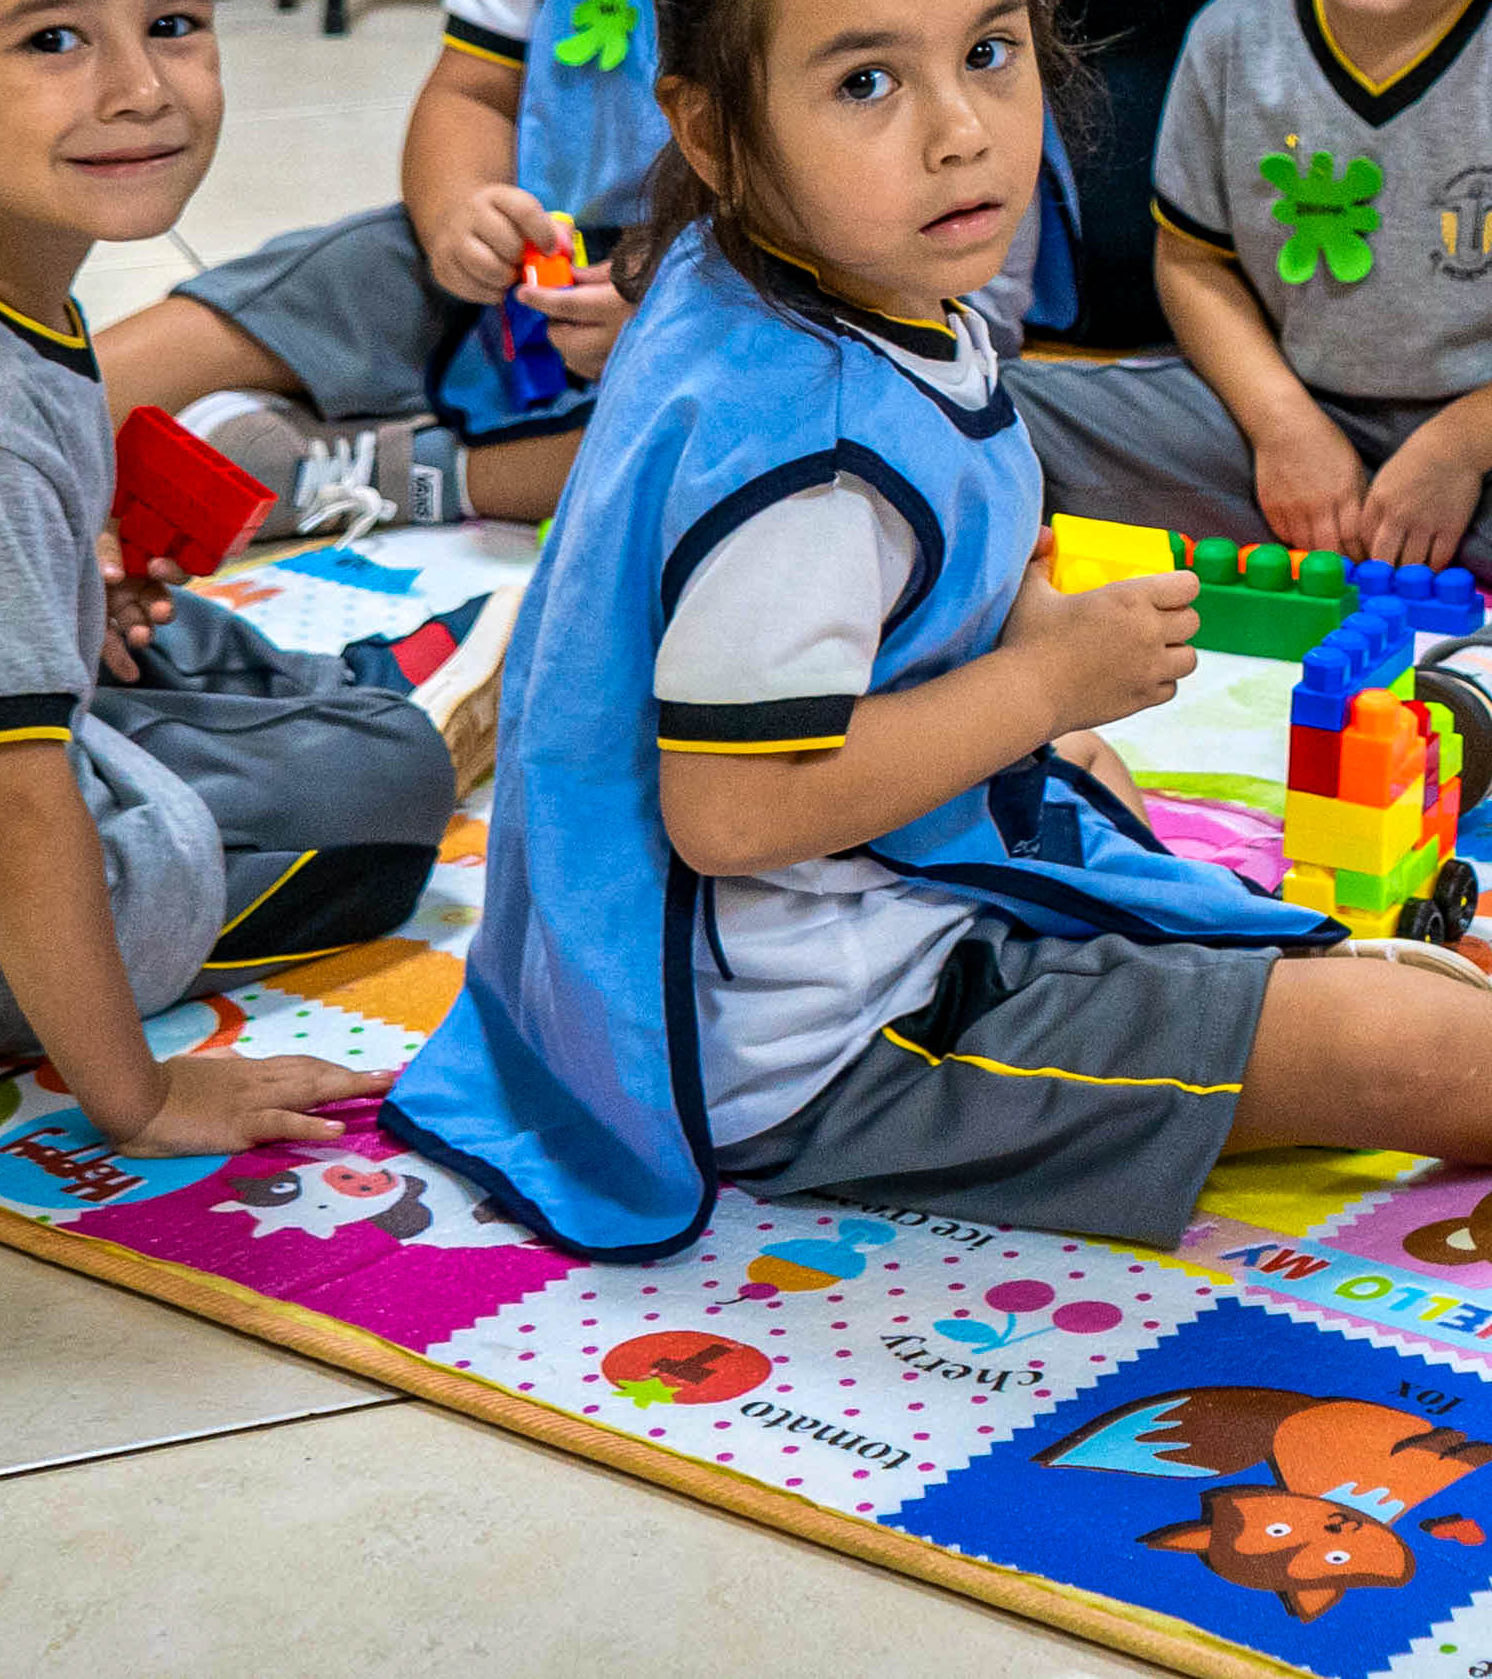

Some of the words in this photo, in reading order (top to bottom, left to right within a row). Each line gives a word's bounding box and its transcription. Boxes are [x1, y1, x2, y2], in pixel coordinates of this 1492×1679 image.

[930, 1220, 997, 1252] ice
[1218, 1241, 1330, 1282] MY
[879, 1333, 1045, 1394] cherry
[1388, 1377, 1465, 1416] fox
[739, 1400, 913, 1472] tomato
